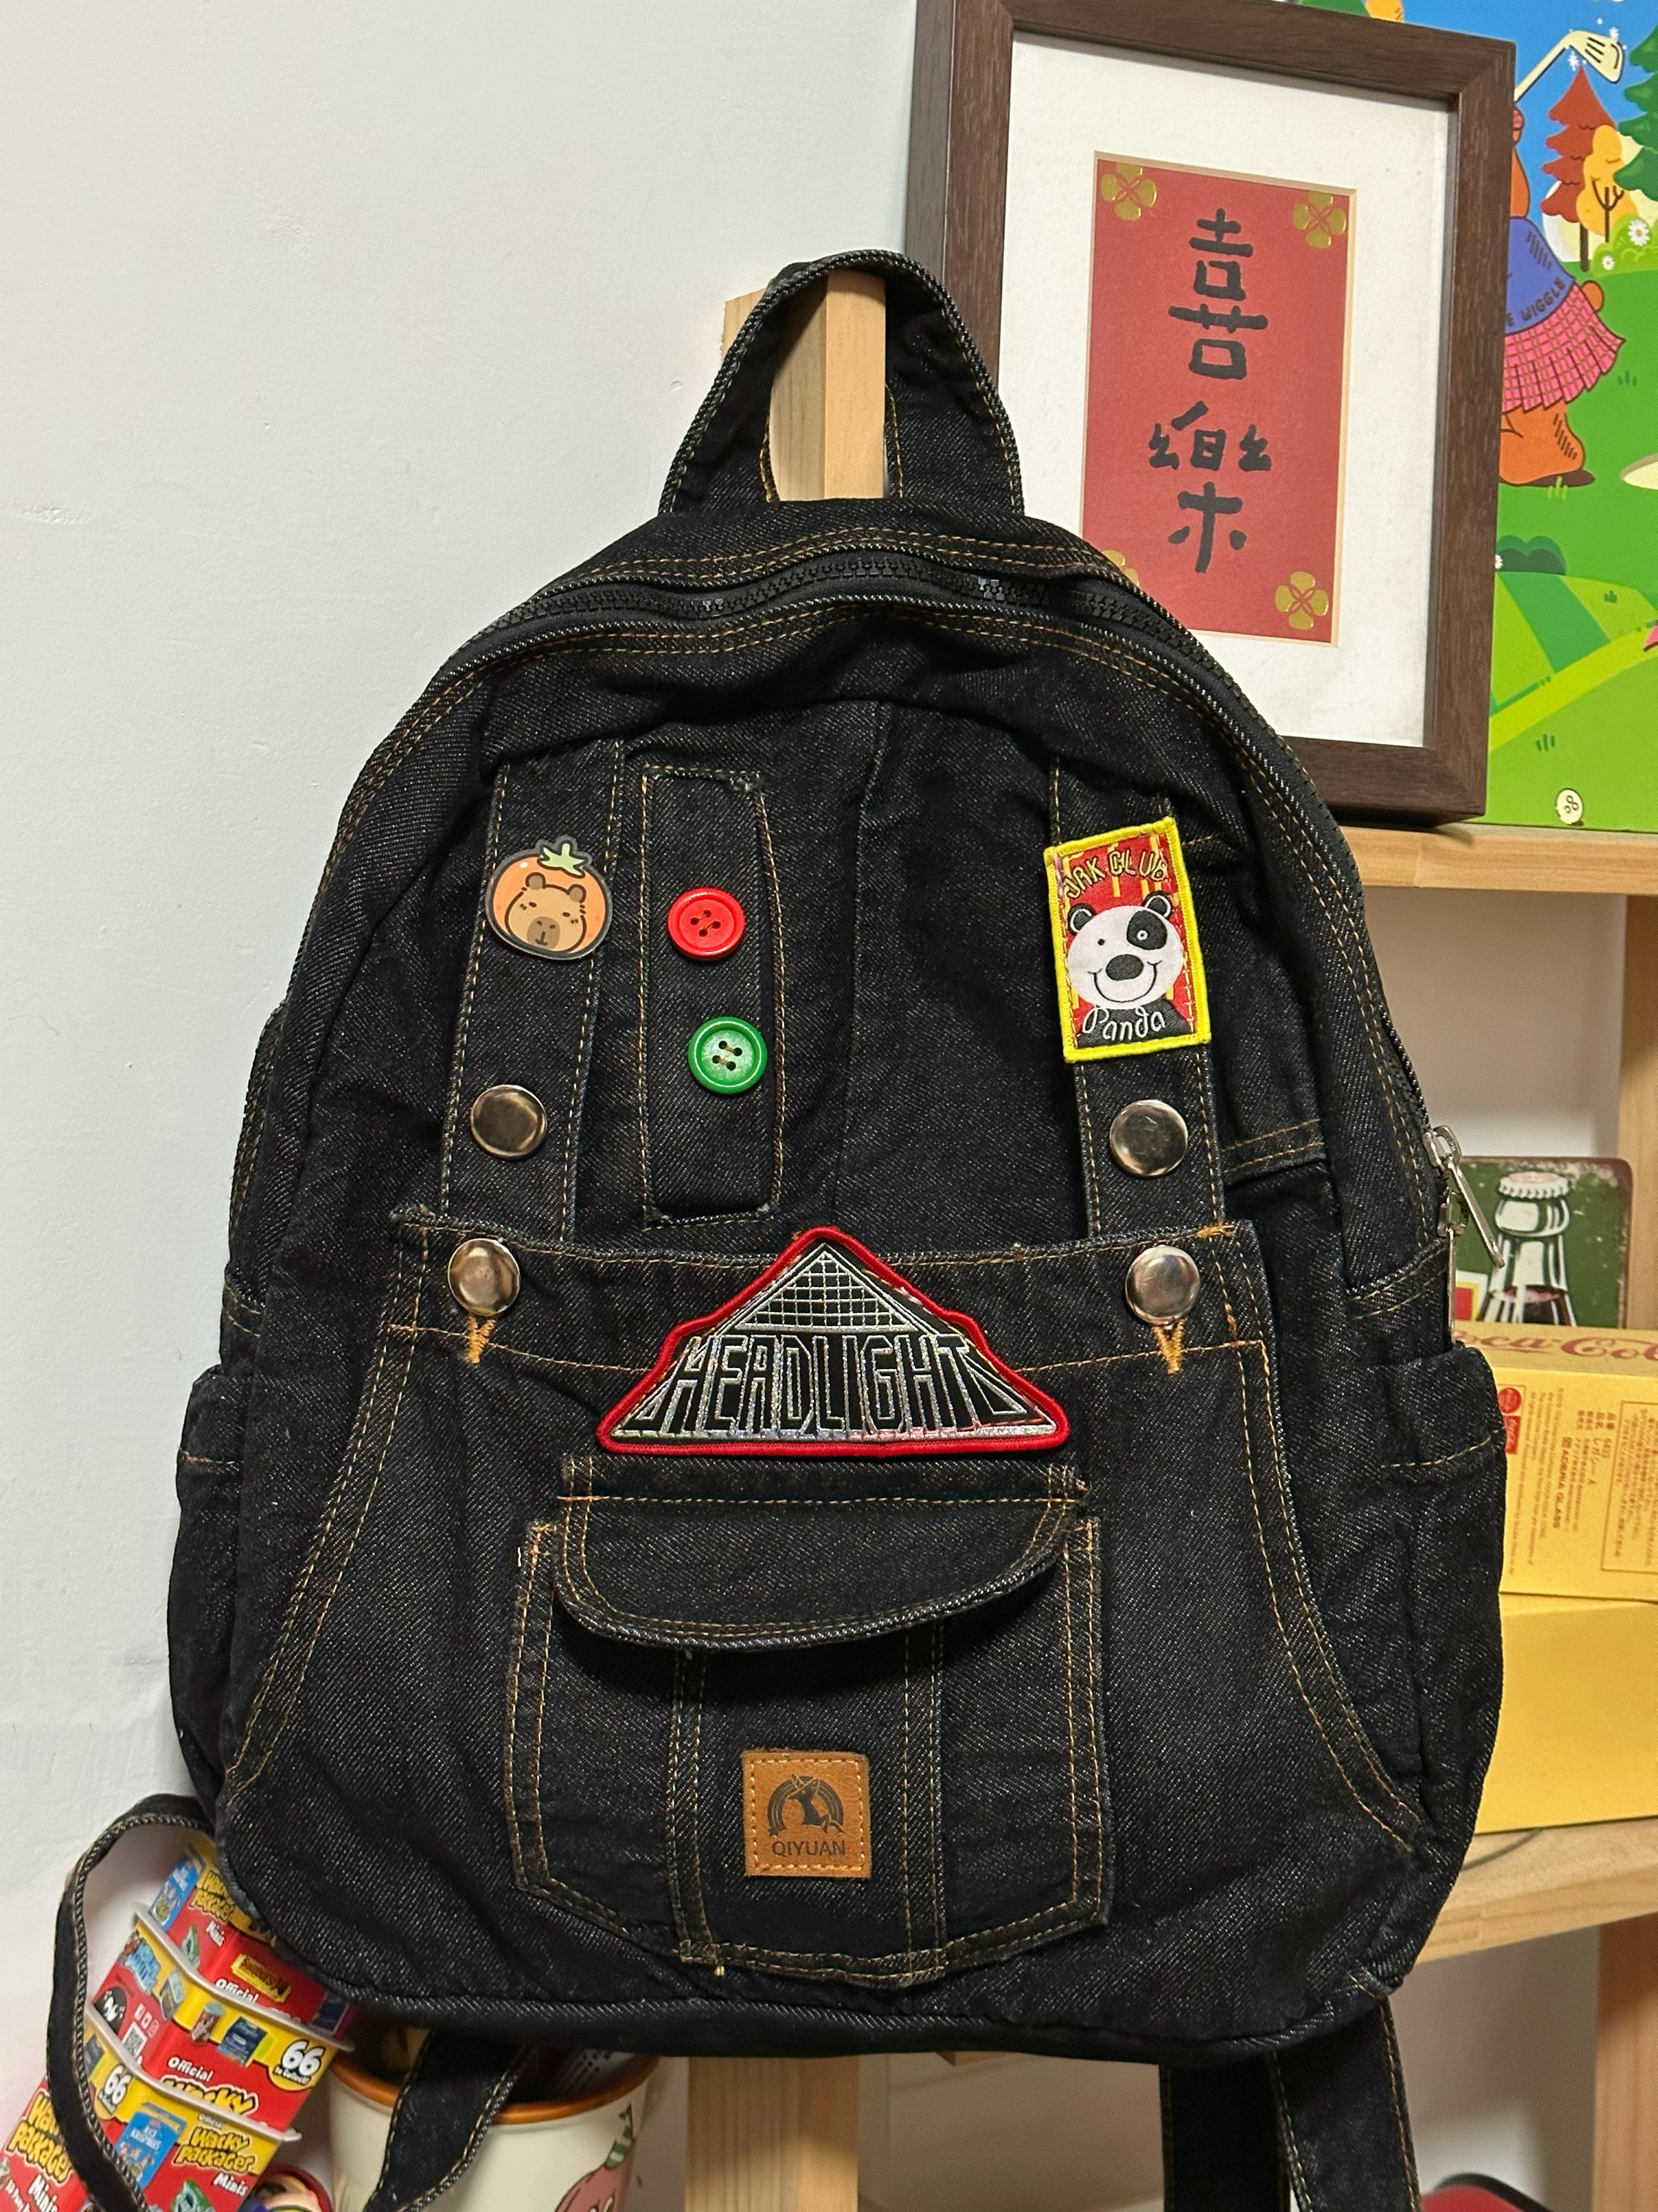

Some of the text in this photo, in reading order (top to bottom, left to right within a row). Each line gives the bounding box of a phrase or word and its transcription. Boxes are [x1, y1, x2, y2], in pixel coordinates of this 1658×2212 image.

[1082, 1004, 1166, 1042] Panda
[632, 1334, 1028, 1435] HEADLIGHT
[772, 1840, 845, 1857] QIYUAN
[167, 2056, 215, 2082] Official
[280, 2039, 325, 2077] 66
[104, 2064, 132, 2105] 66
[213, 2171, 248, 2196] Minis
